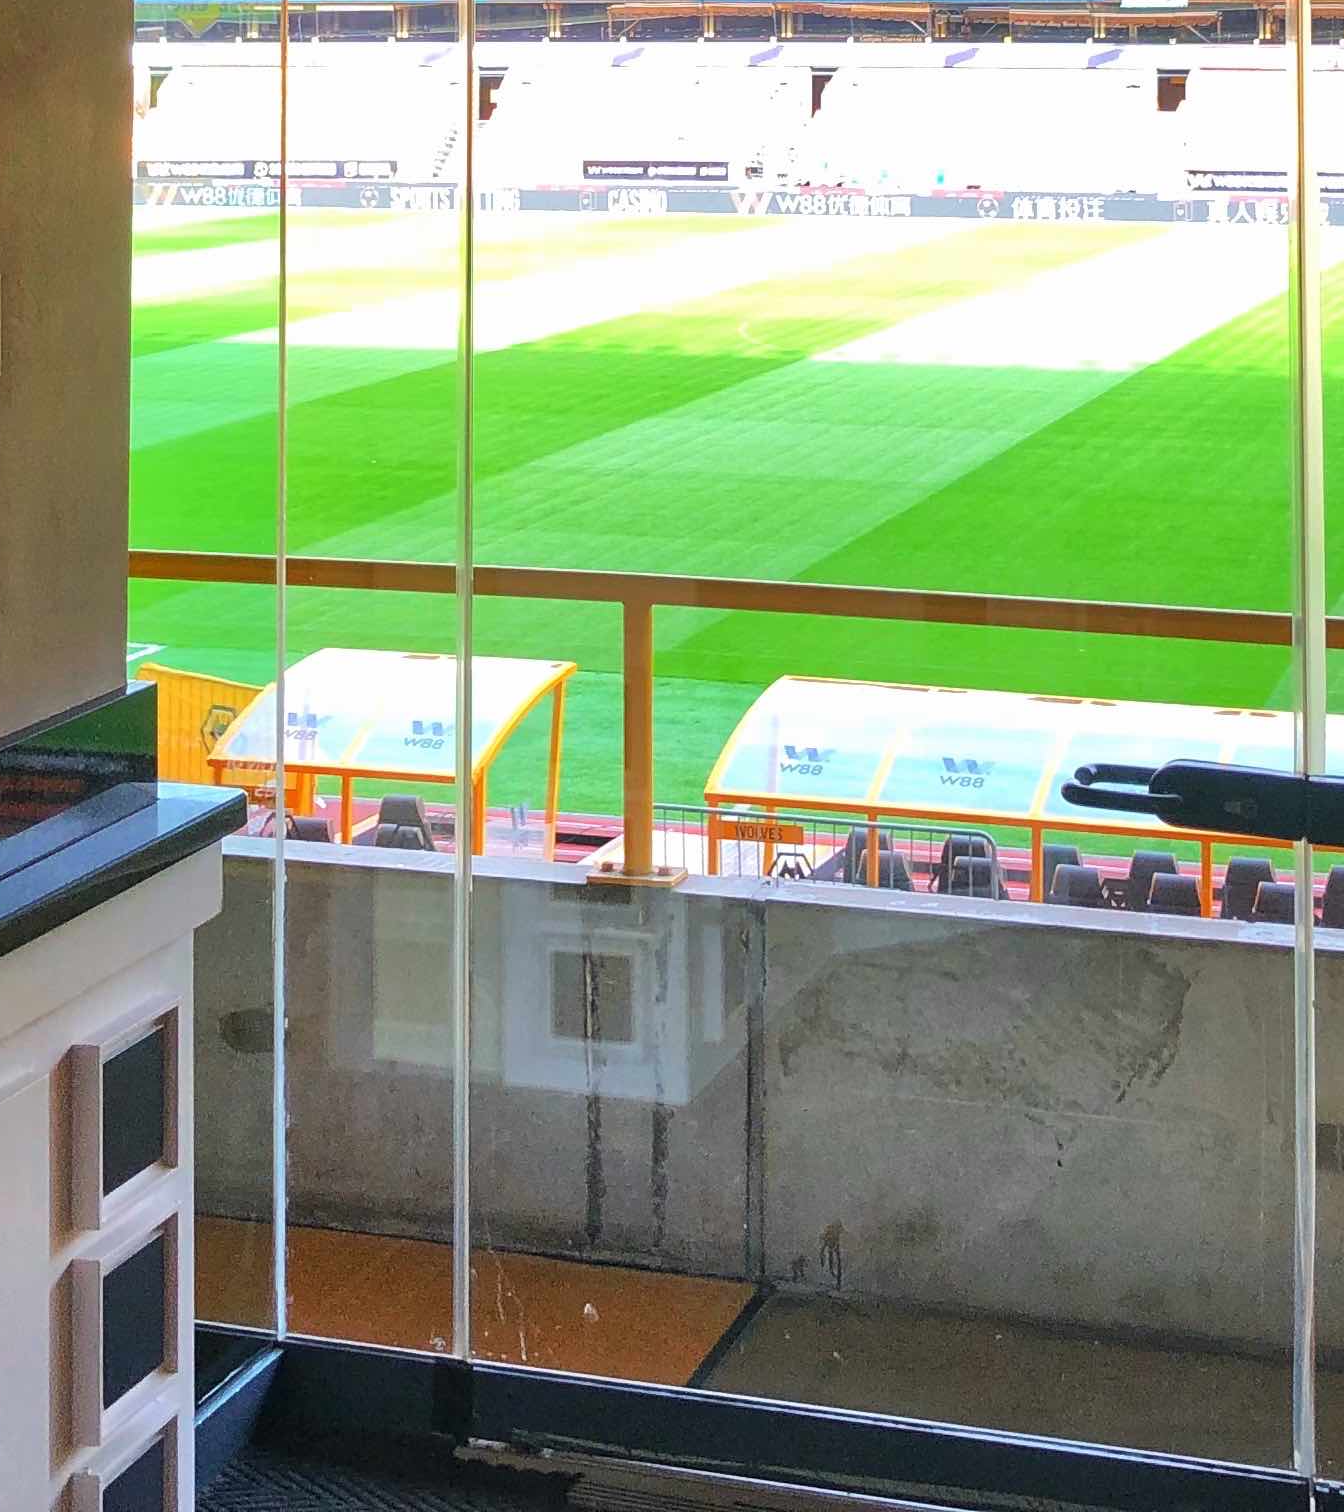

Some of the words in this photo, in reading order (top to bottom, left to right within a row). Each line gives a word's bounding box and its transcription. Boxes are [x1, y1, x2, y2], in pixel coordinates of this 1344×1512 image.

[404, 737, 444, 750] W88
[780, 763, 823, 776] W88
[940, 775, 985, 788] W88
